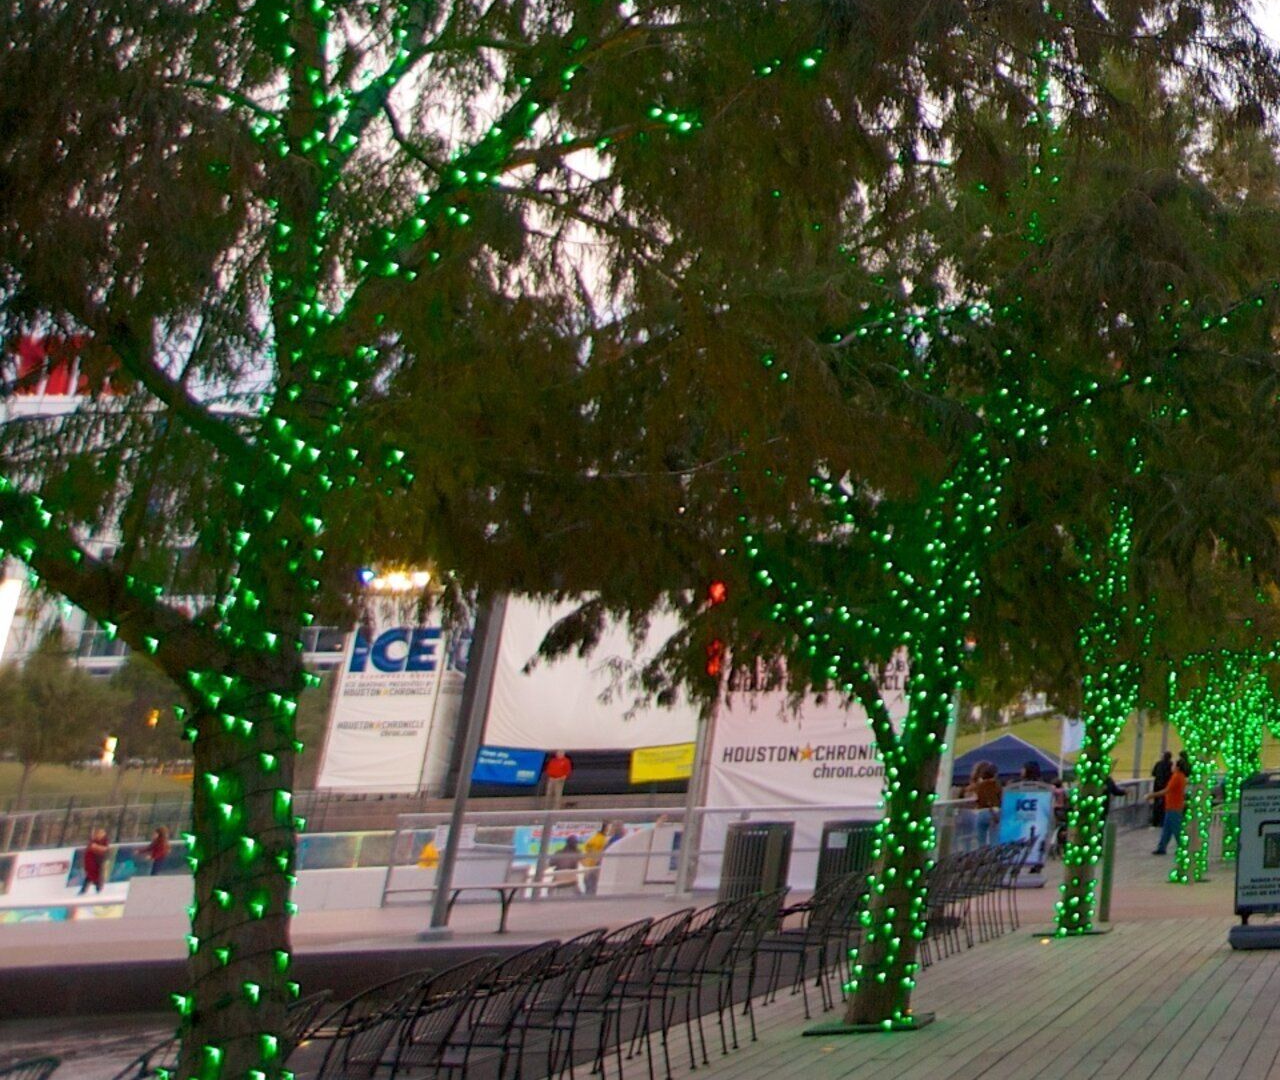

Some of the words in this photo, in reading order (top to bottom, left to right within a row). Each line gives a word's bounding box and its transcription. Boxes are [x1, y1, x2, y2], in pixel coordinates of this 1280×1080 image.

[349, 626, 442, 673] ICE
[344, 688, 381, 696] HOUSTON
[389, 687, 432, 696] CHRONICLE
[337, 722, 373, 730] HOUSTON
[382, 720, 424, 729] CHRONICLE
[722, 746, 800, 763] HOUSTON
[814, 744, 878, 761] CHRONI
[813, 763, 886, 779] chron.com
[1015, 799, 1039, 812] ICE
